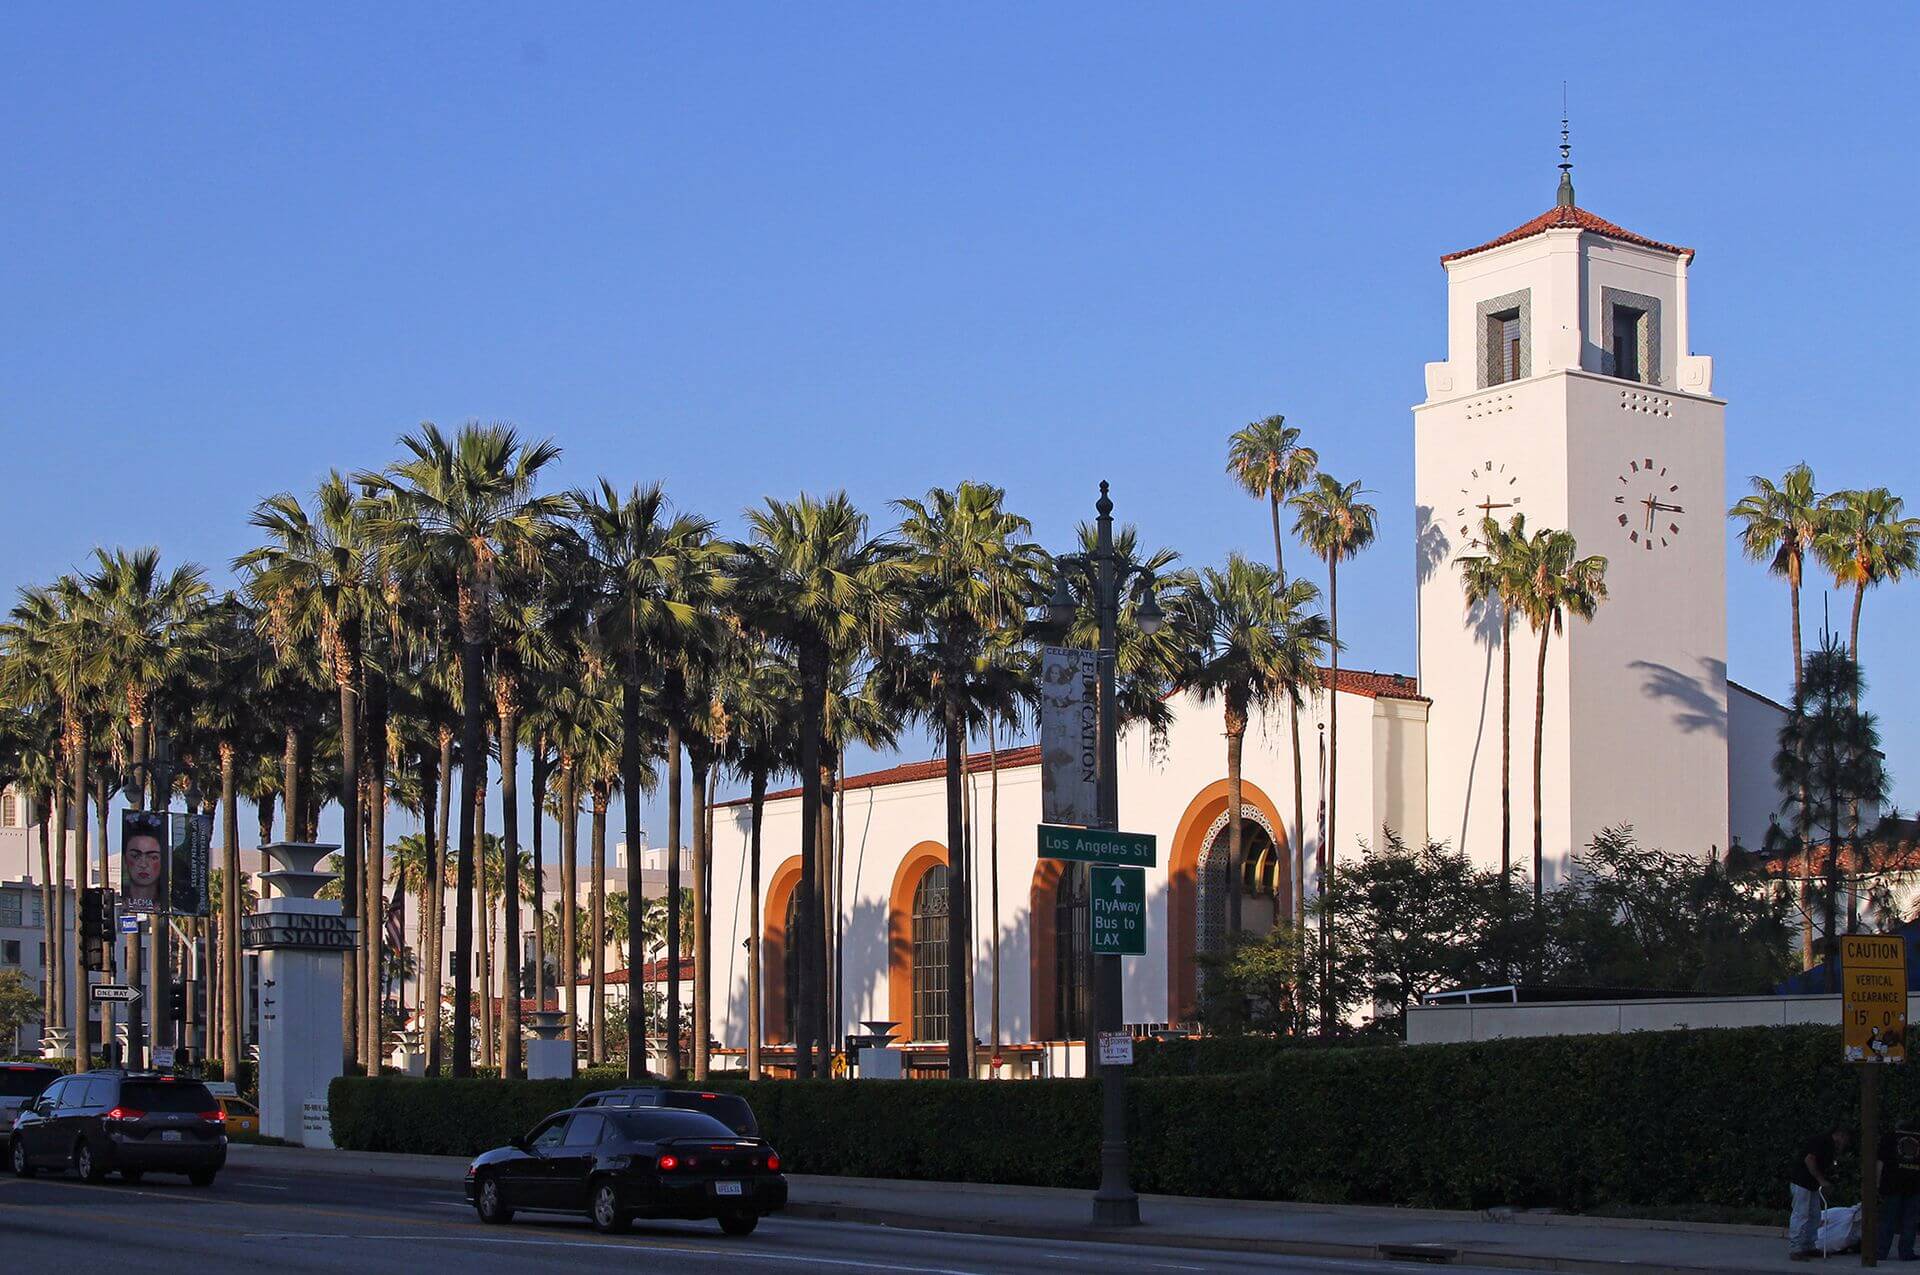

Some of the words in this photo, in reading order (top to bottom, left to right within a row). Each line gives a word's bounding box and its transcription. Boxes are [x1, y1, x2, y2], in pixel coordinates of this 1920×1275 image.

[1046, 646, 1094, 659] CELEBRATE
[1082, 661, 1095, 784] EDUCATION
[1046, 836, 1069, 850] Los
[1076, 839, 1127, 856] Angeles
[1134, 843, 1149, 857] St
[128, 899, 153, 907] LACMA
[1095, 899, 1140, 915] FlyAway
[288, 915, 346, 931] UNION
[1095, 916, 1118, 930] Bus
[1125, 918, 1136, 930] to
[282, 930, 353, 946] STATION
[1095, 933, 1120, 946] LAX
[1848, 942, 1898, 959] CAUTION
[1856, 974, 1893, 986] VERTICAL
[1851, 992, 1899, 1003] CLEARANCE
